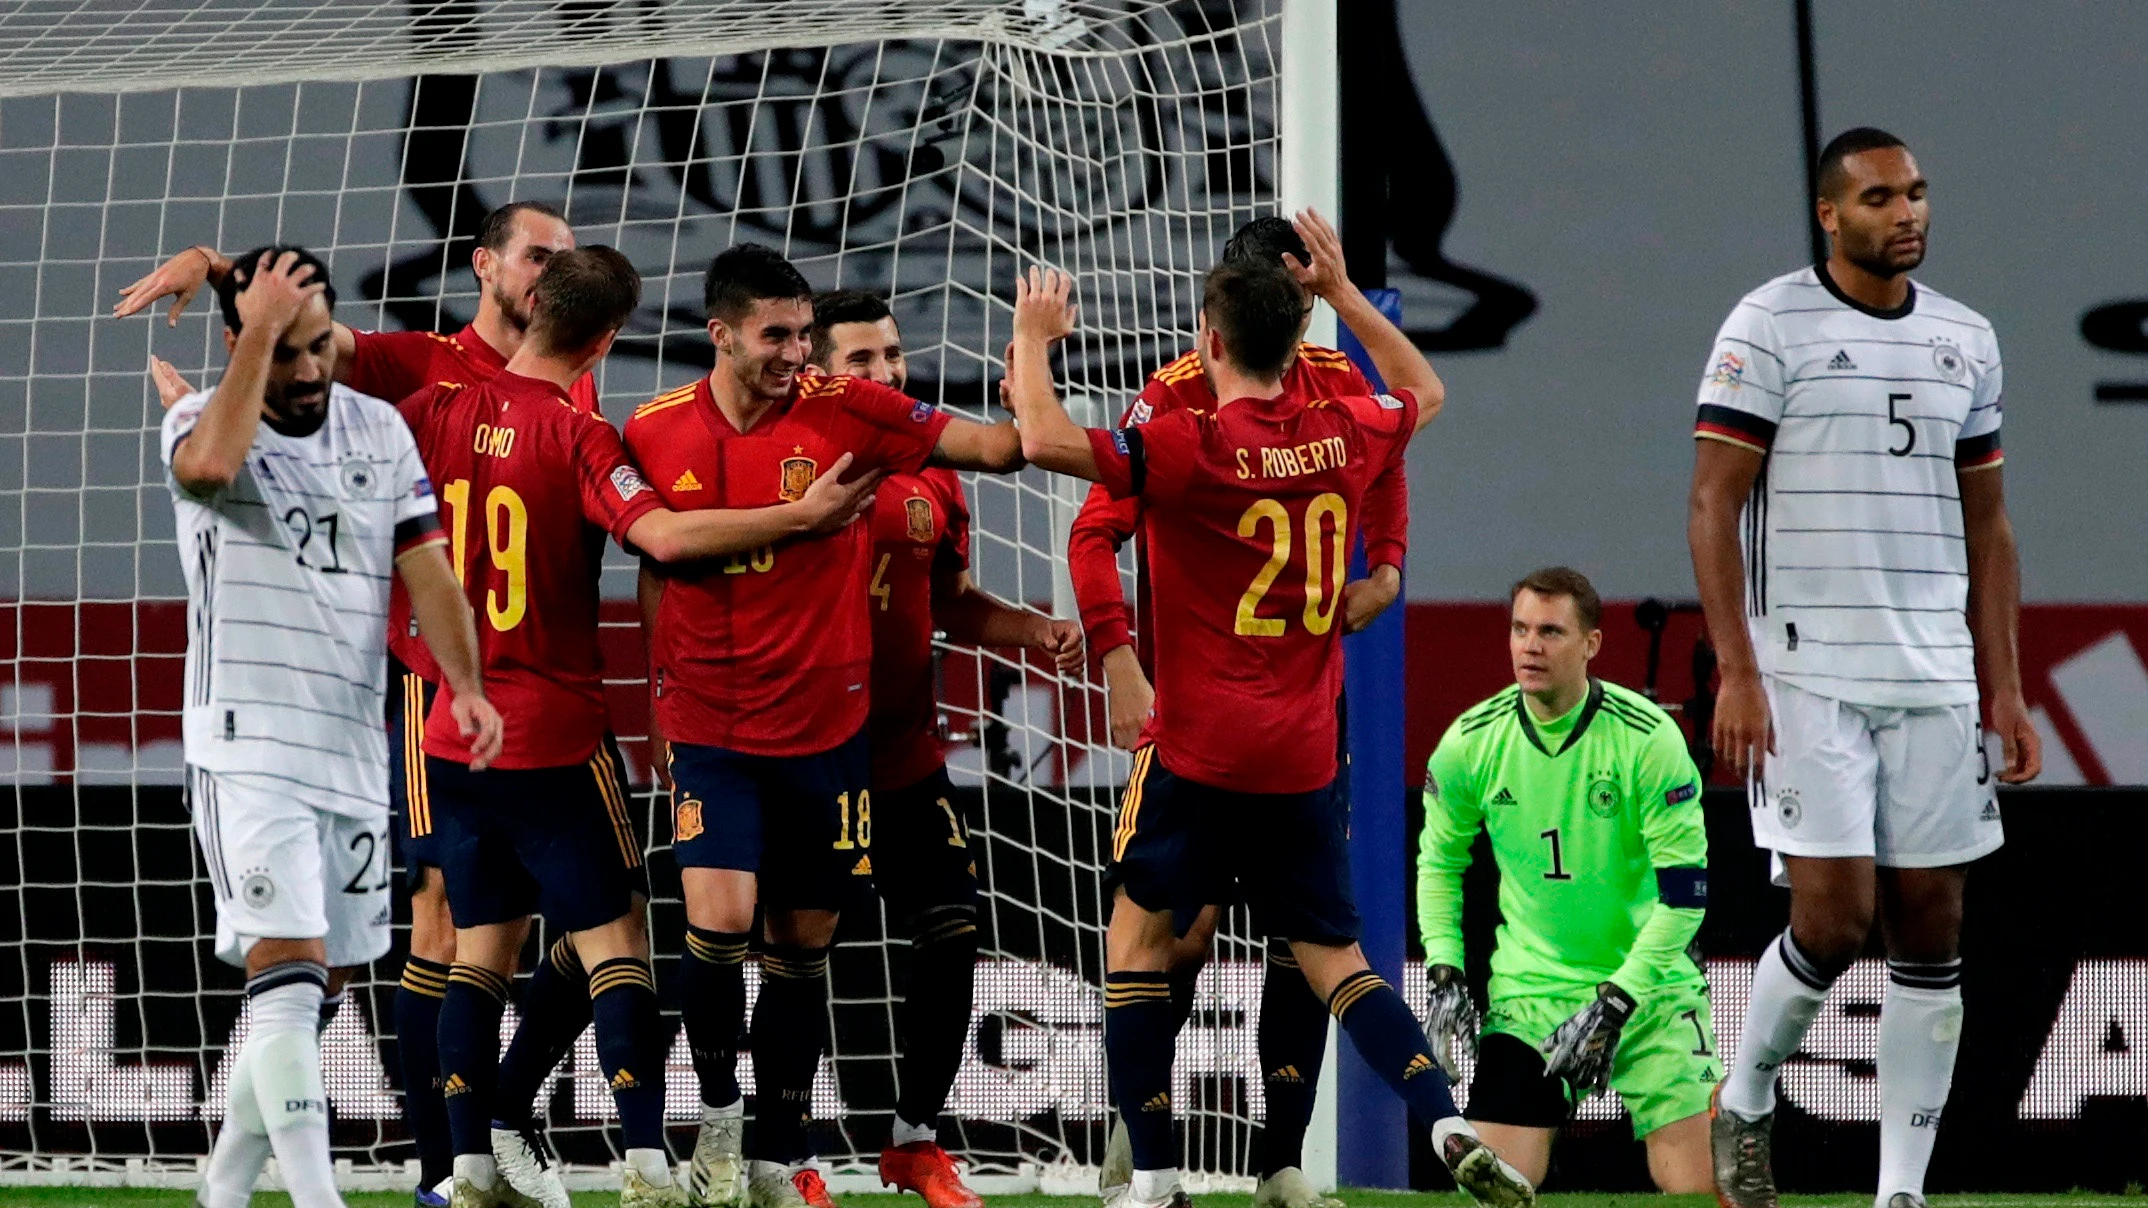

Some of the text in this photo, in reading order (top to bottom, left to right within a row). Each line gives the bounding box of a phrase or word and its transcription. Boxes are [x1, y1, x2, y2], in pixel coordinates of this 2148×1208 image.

[1888, 393, 1916, 457] 5
[1235, 436, 1347, 480] S. ROBERTO
[285, 507, 348, 574] 21
[443, 478, 528, 632] 19
[1234, 492, 1347, 637] 20
[833, 789, 872, 850] 18
[936, 797, 970, 848] 1
[1540, 828, 1572, 880] 1
[1681, 1008, 1713, 1056] 1
